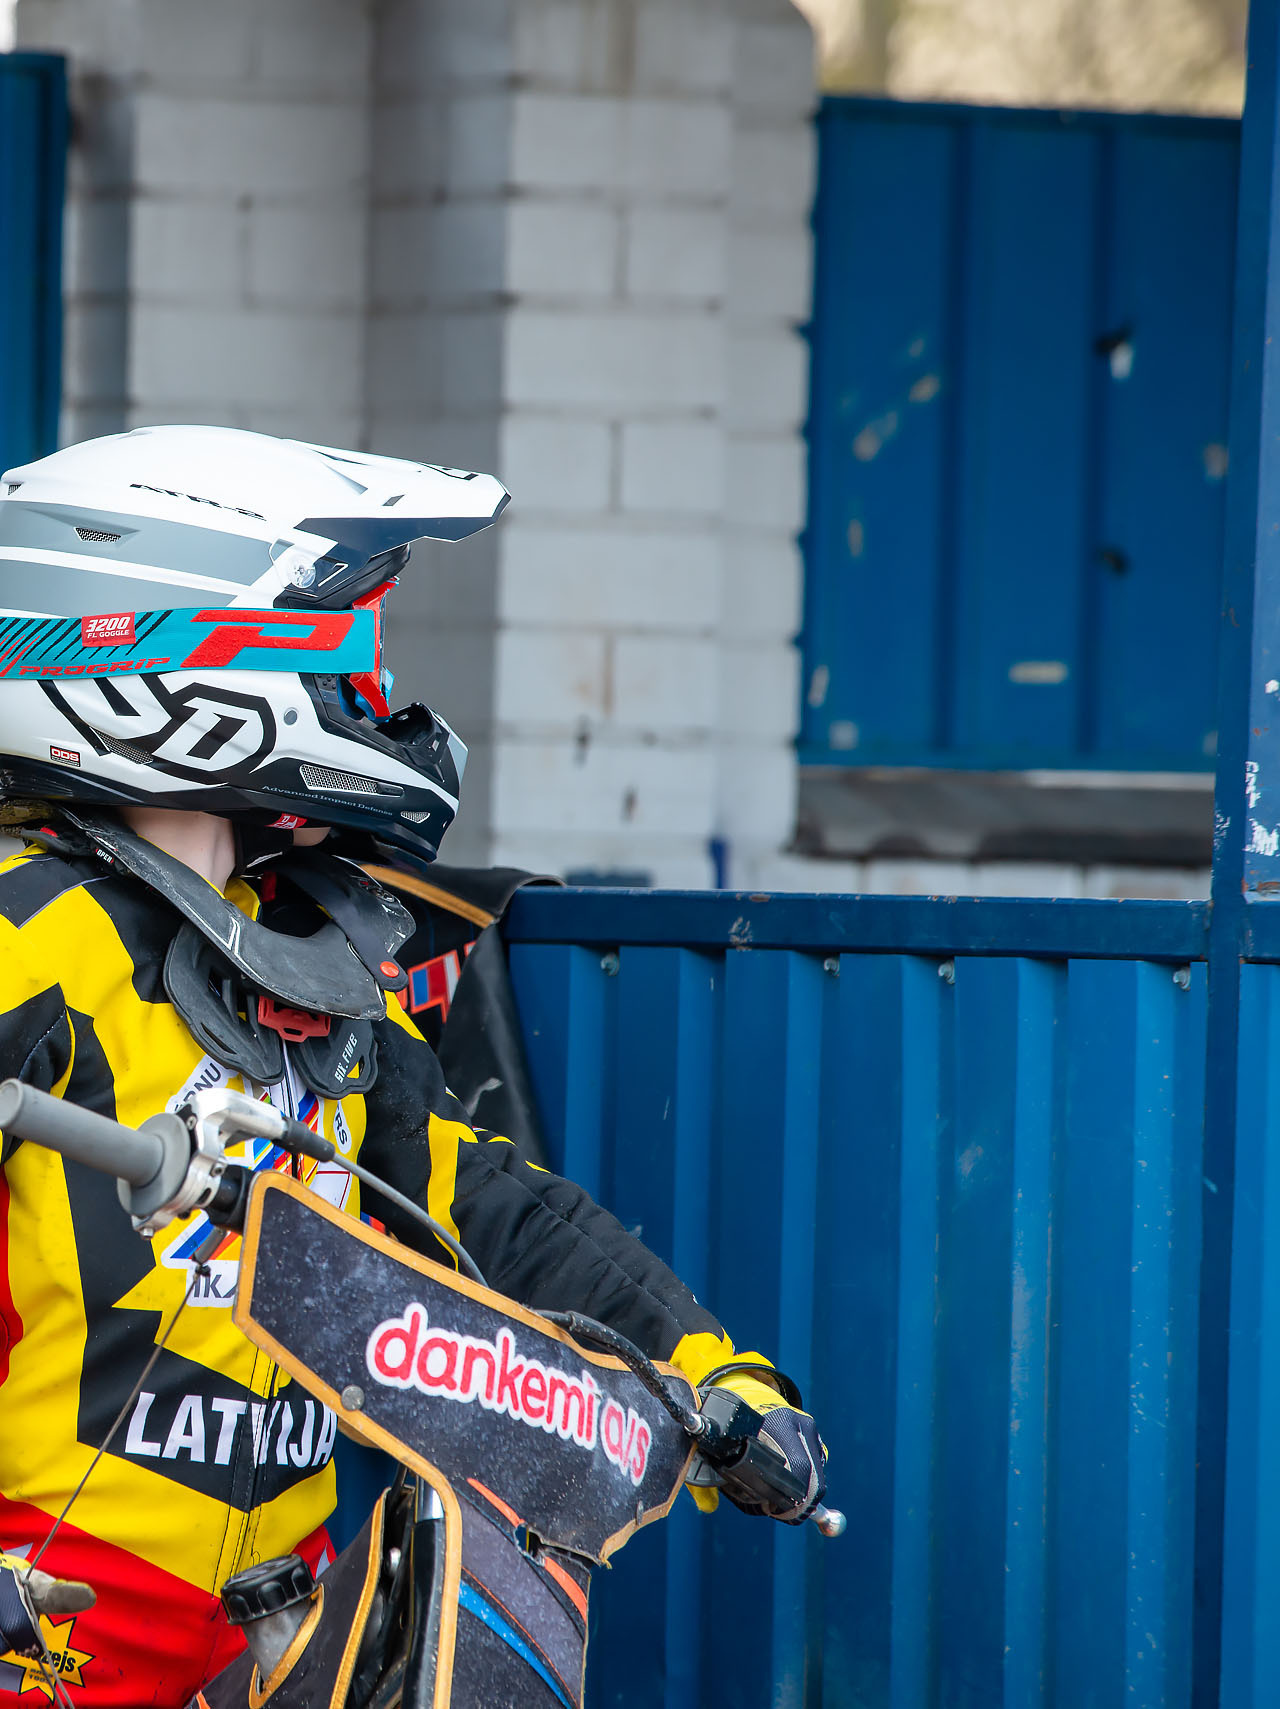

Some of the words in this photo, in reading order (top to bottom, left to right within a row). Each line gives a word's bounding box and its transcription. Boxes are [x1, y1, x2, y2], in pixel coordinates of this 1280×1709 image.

[85, 616, 131, 633] 3200
[87, 630, 98, 639] FL
[99, 628, 130, 638] GOGGLE
[51, 748, 80, 763] ODS
[262, 785, 318, 801] Advanced
[320, 795, 357, 808] Impact
[358, 803, 393, 816] Defense
[96, 848, 113, 863] OPEN
[375, 1311, 597, 1443] dankemi
[125, 1391, 338, 1468] LATVIJA
